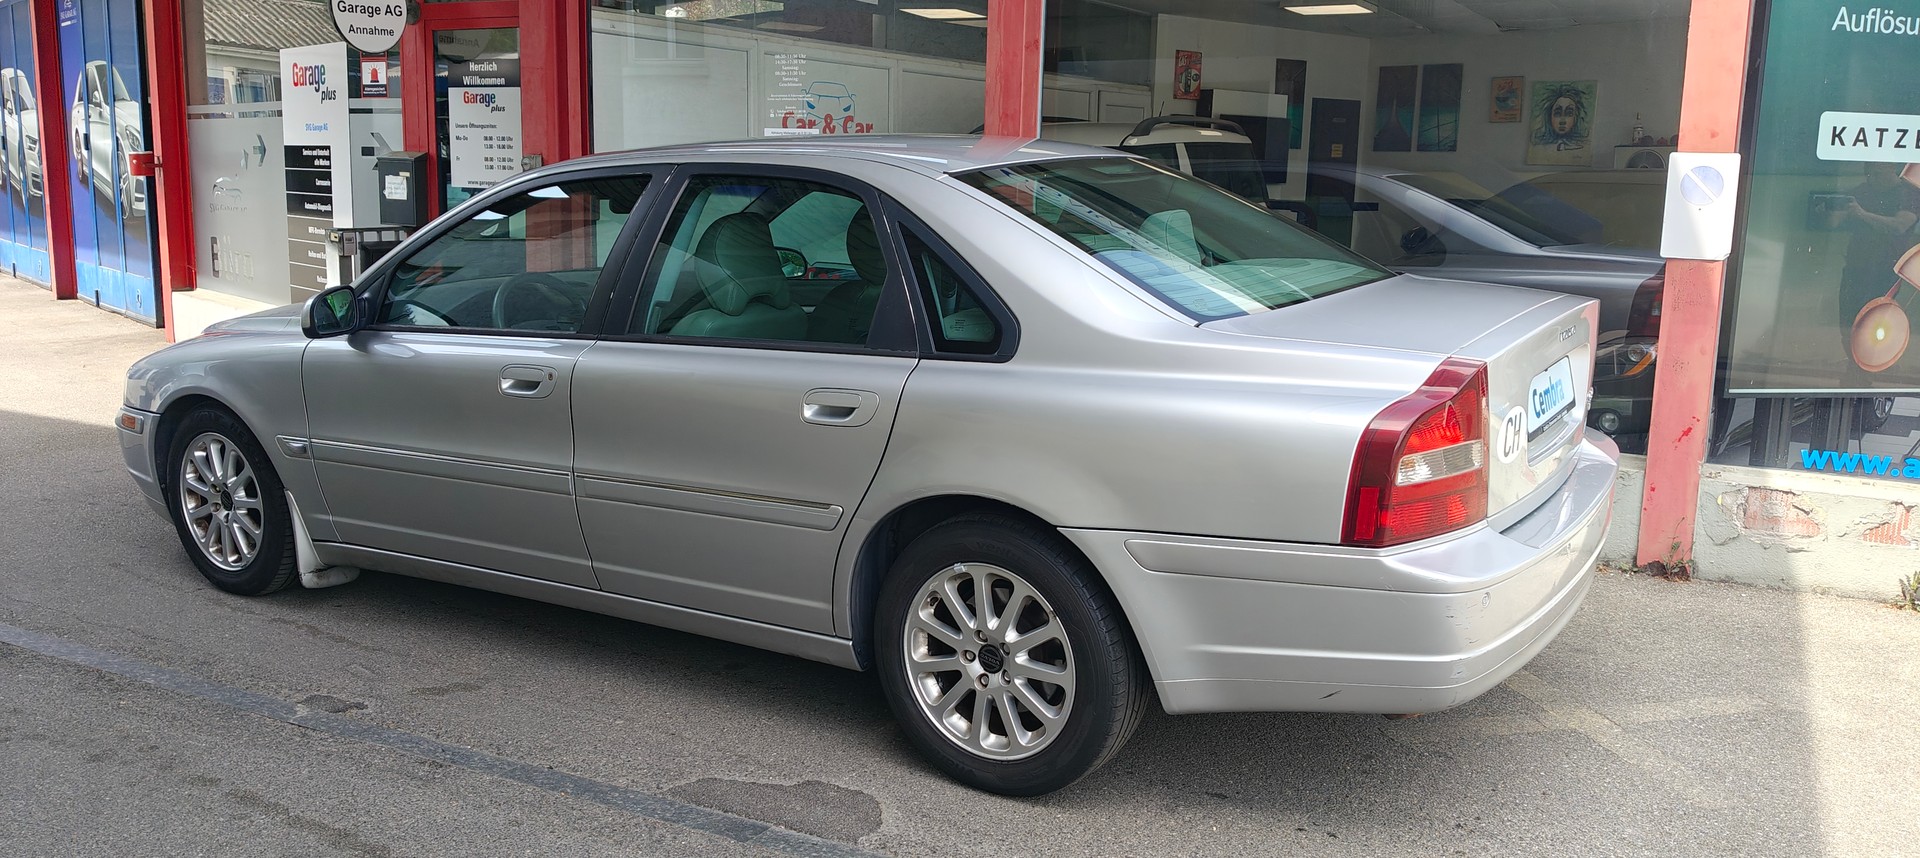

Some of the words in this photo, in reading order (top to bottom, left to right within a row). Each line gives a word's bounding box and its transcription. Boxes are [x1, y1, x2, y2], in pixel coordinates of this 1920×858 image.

[337, 0, 381, 18] Garage
[384, 4, 403, 17] AG
[1831, 6, 1920, 36] Auflösu
[348, 24, 395, 37] Annahme
[469, 61, 498, 72] Herzlich
[292, 62, 326, 93] Garage
[462, 75, 506, 86] Willkommen
[321, 86, 337, 104] plus
[463, 91, 496, 107] Garage
[490, 105, 506, 114] plus
[781, 111, 817, 129] Car
[822, 113, 836, 134] &
[842, 115, 874, 134] Car
[1532, 375, 1565, 419] Cembra
[1503, 411, 1522, 458] CH
[1800, 449, 1920, 479] www.a
